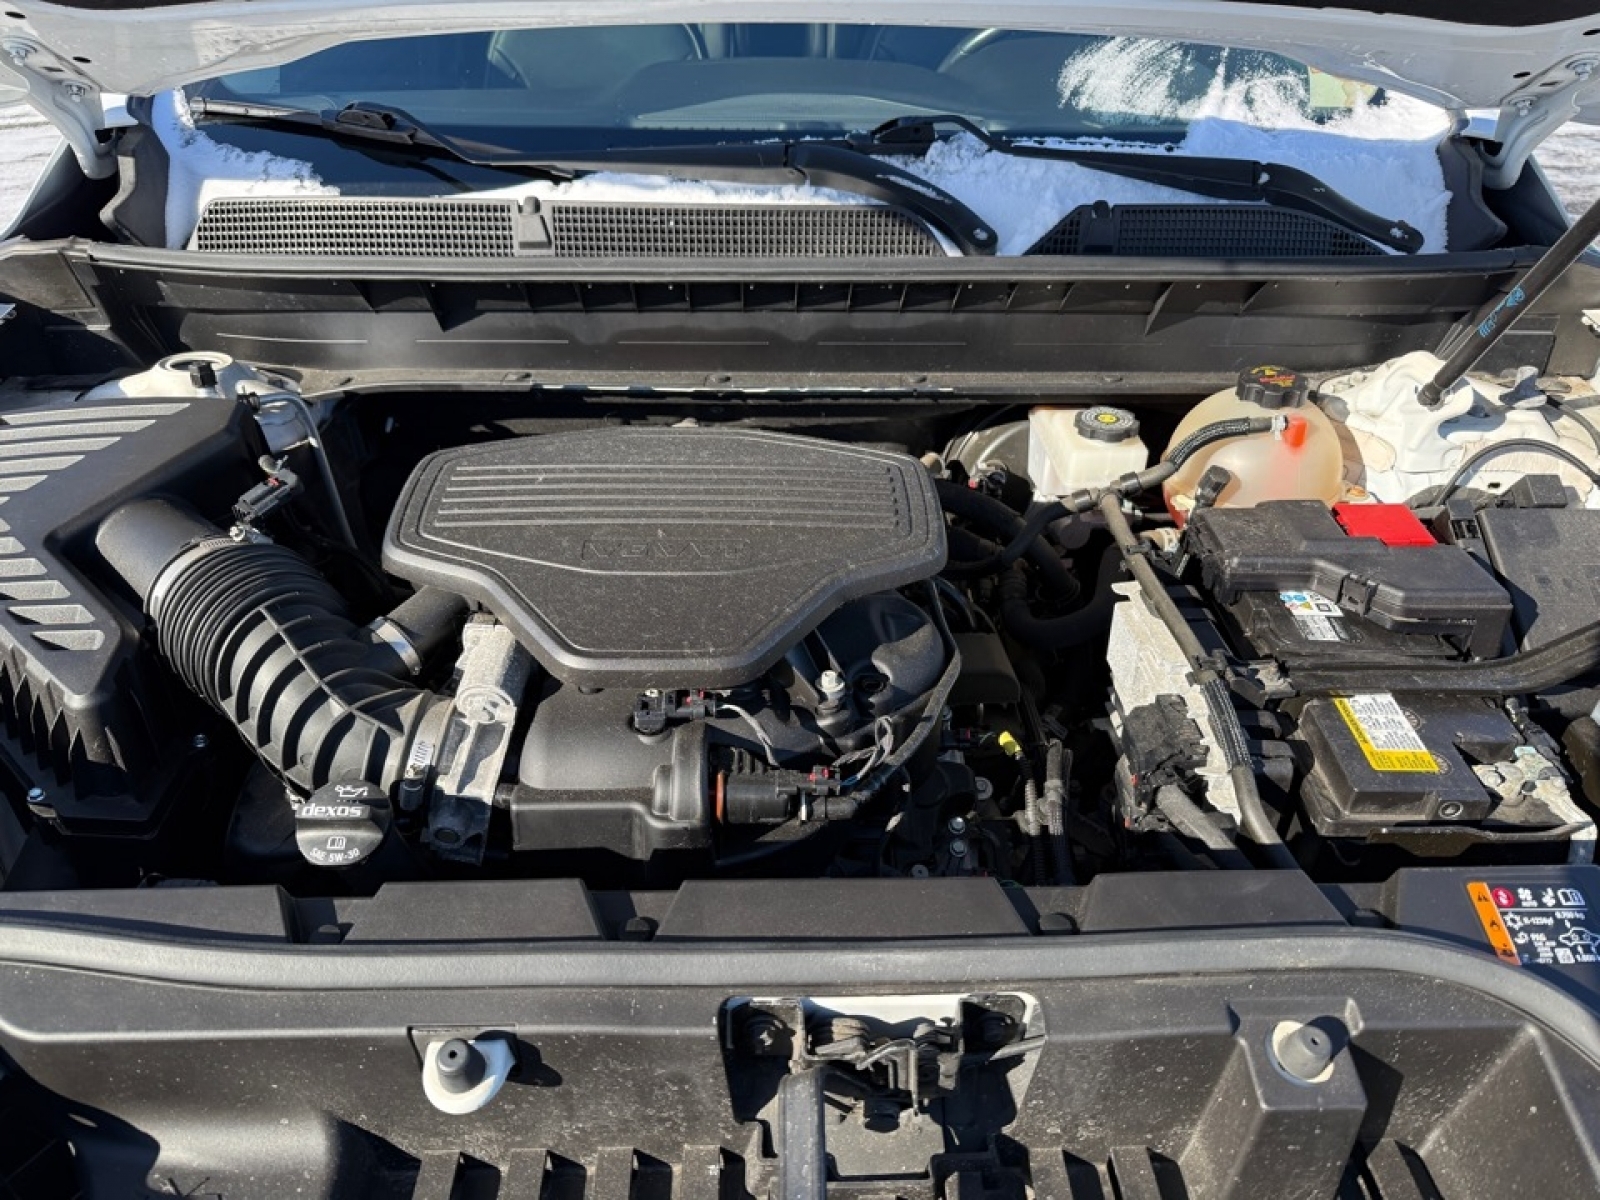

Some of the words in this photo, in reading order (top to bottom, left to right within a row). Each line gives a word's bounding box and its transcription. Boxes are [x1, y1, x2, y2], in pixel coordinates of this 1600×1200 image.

[302, 803, 363, 817] dexos
[310, 848, 327, 861] SAE
[329, 848, 361, 862] 5W-30
